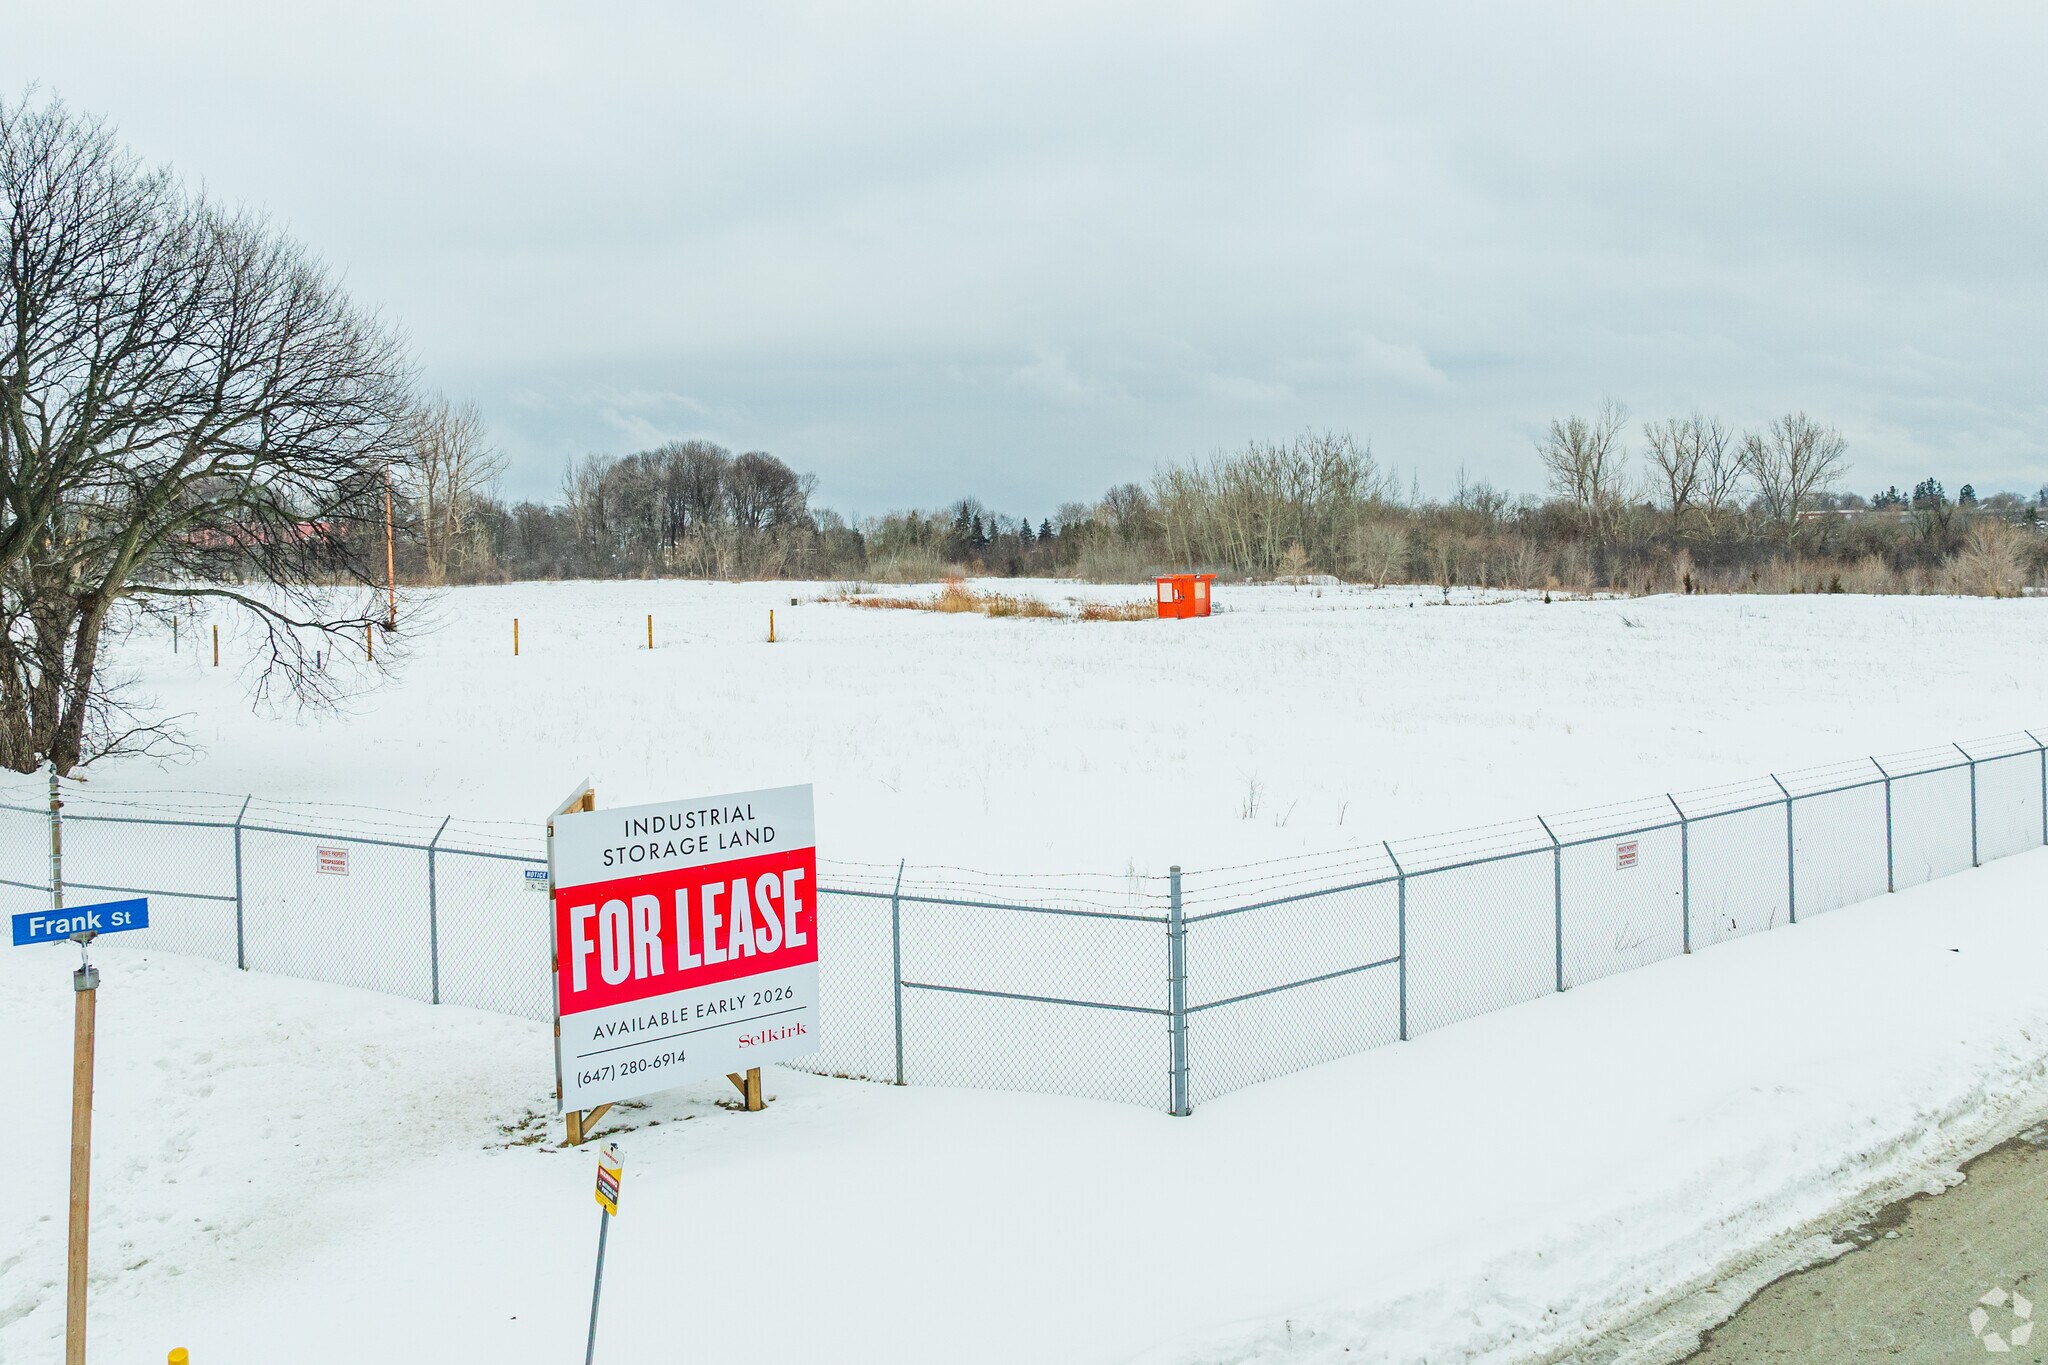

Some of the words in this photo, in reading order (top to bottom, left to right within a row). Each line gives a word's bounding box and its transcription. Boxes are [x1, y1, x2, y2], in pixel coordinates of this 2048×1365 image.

[625, 804, 755, 837] INDUSTRIAL
[603, 835, 708, 867] STORAGE
[719, 826, 775, 850] LAND
[526, 871, 547, 879] NOTICE
[29, 910, 103, 937] Frank
[111, 911, 132, 926] St
[570, 894, 664, 993] FOR
[675, 867, 807, 971] LEASE
[593, 1007, 689, 1041] AVAILABLE
[696, 995, 746, 1018] EARLY
[753, 985, 793, 1006] 2026
[738, 1022, 807, 1049] Selkirk
[577, 1064, 615, 1088] (647)
[620, 1050, 686, 1077] 280-6914
